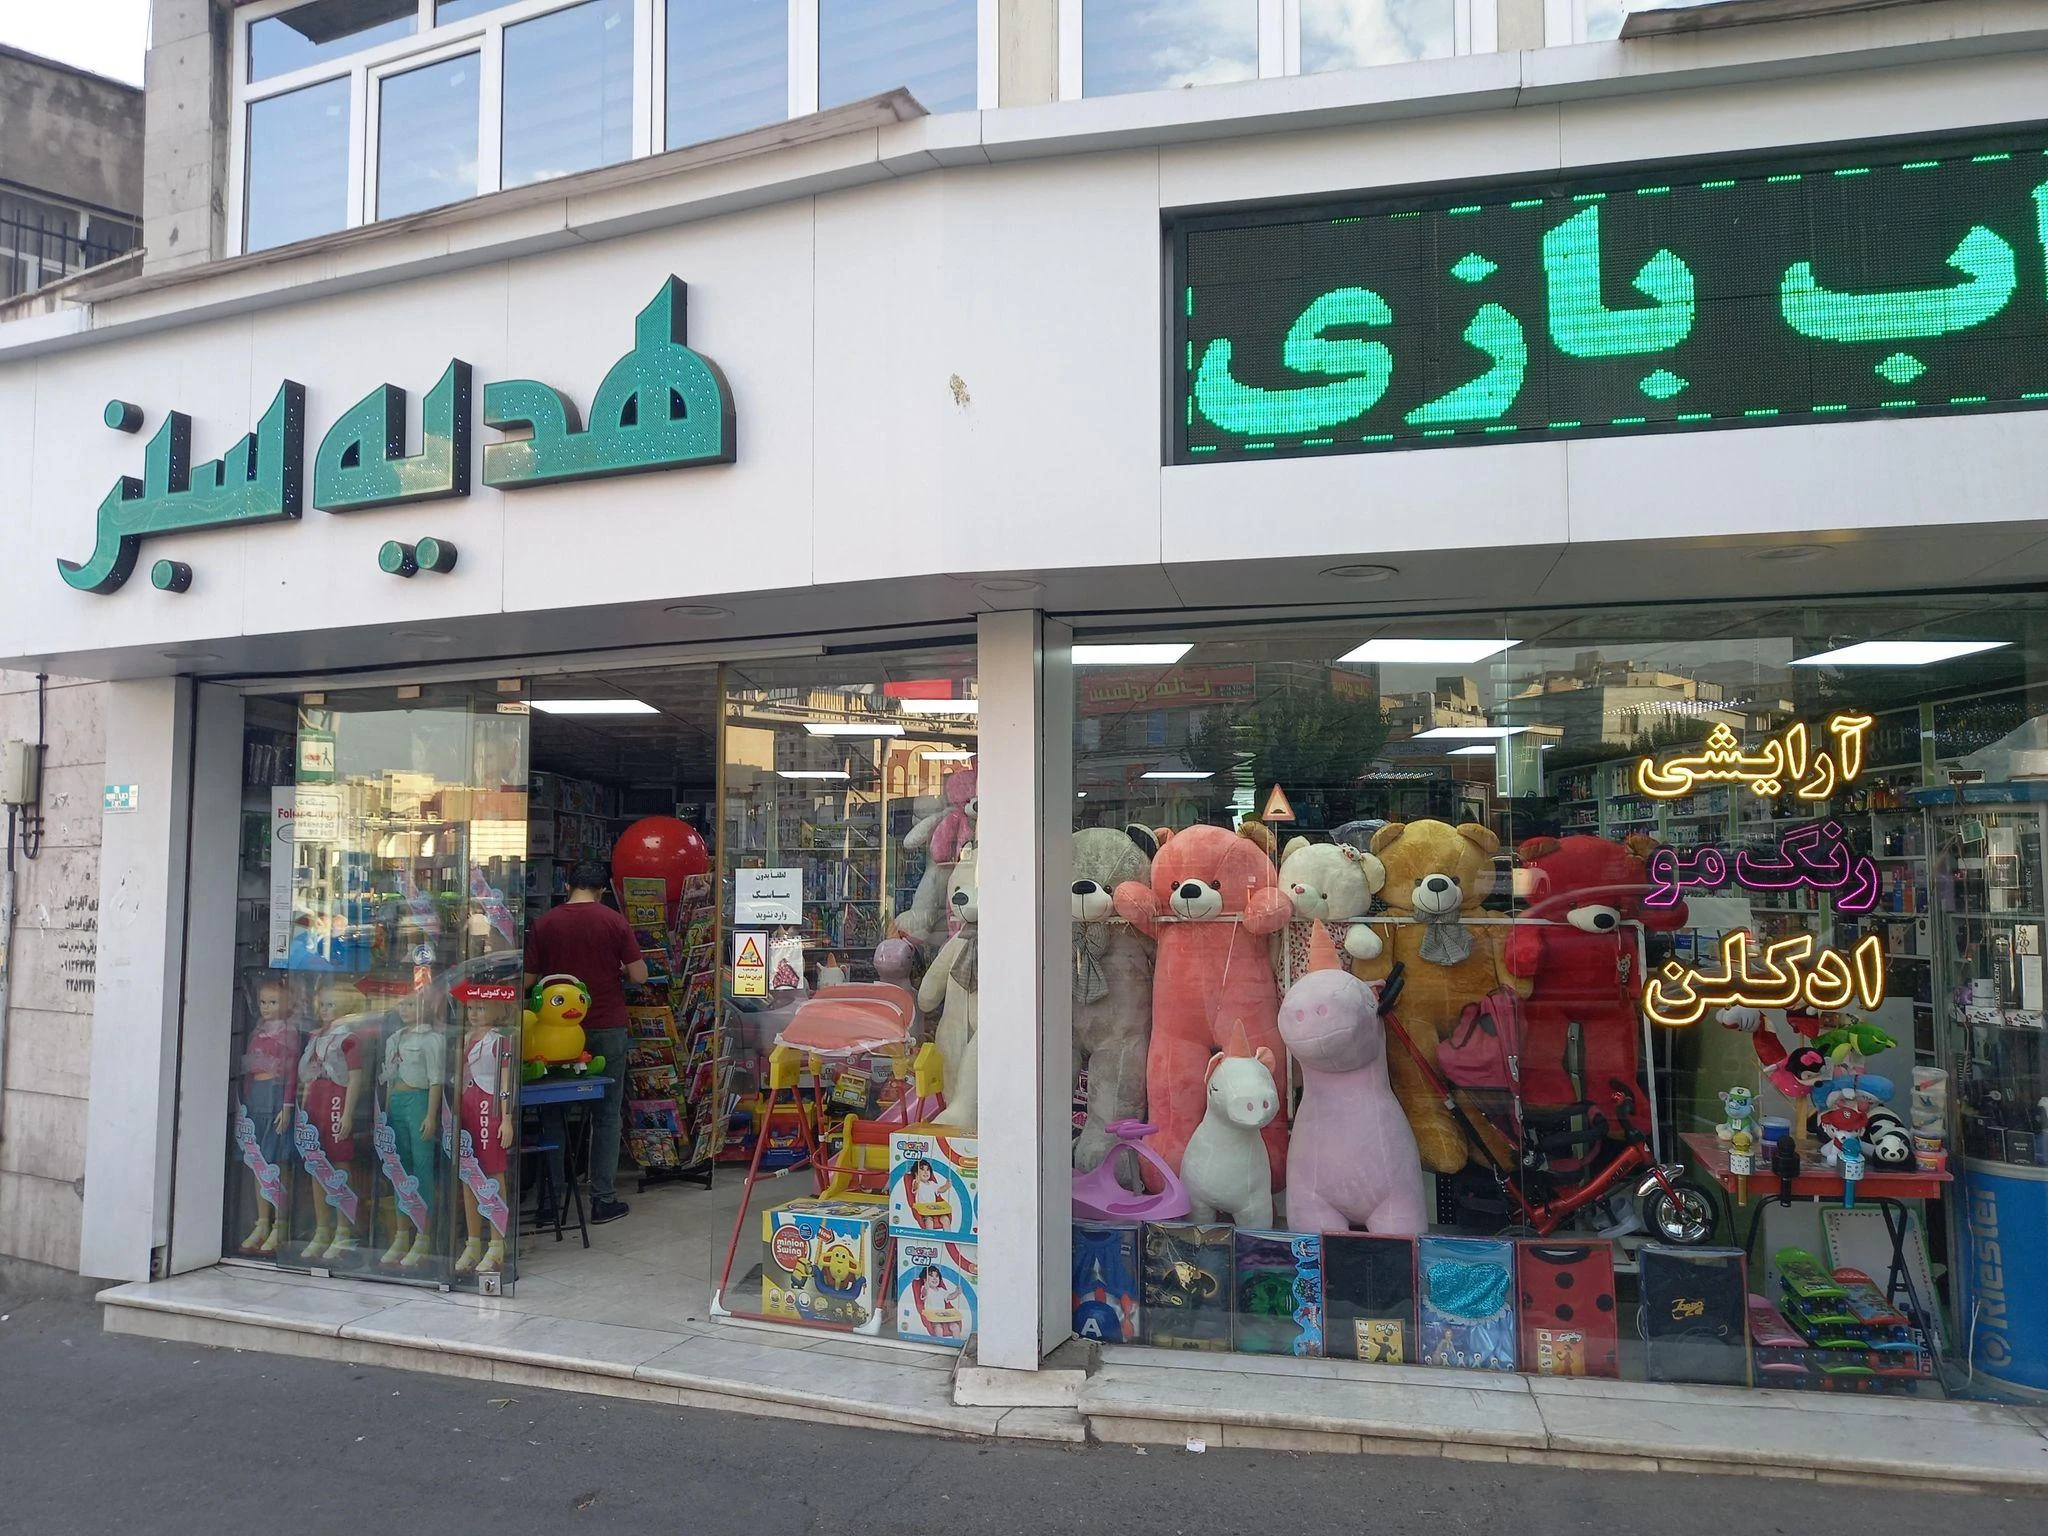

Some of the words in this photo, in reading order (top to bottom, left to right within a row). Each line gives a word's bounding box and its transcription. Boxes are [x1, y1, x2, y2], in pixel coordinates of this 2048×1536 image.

[1194, 204, 1695, 435] بازی
[313, 273, 737, 579] هدیه
[56, 378, 306, 595] سبز
[1638, 715, 1873, 797] آرایشی
[1644, 848, 1726, 906] مو
[1736, 820, 1879, 909] رنگ
[752, 889, 791, 899] ماسک
[755, 910, 773, 921] نشوید
[774, 911, 788, 921] وارد
[466, 987, 480, 996] است
[500, 989, 515, 999] درب
[1645, 931, 1883, 1026] ادکلن
[776, 1237, 805, 1248] minion
[776, 1245, 802, 1257] Swing
